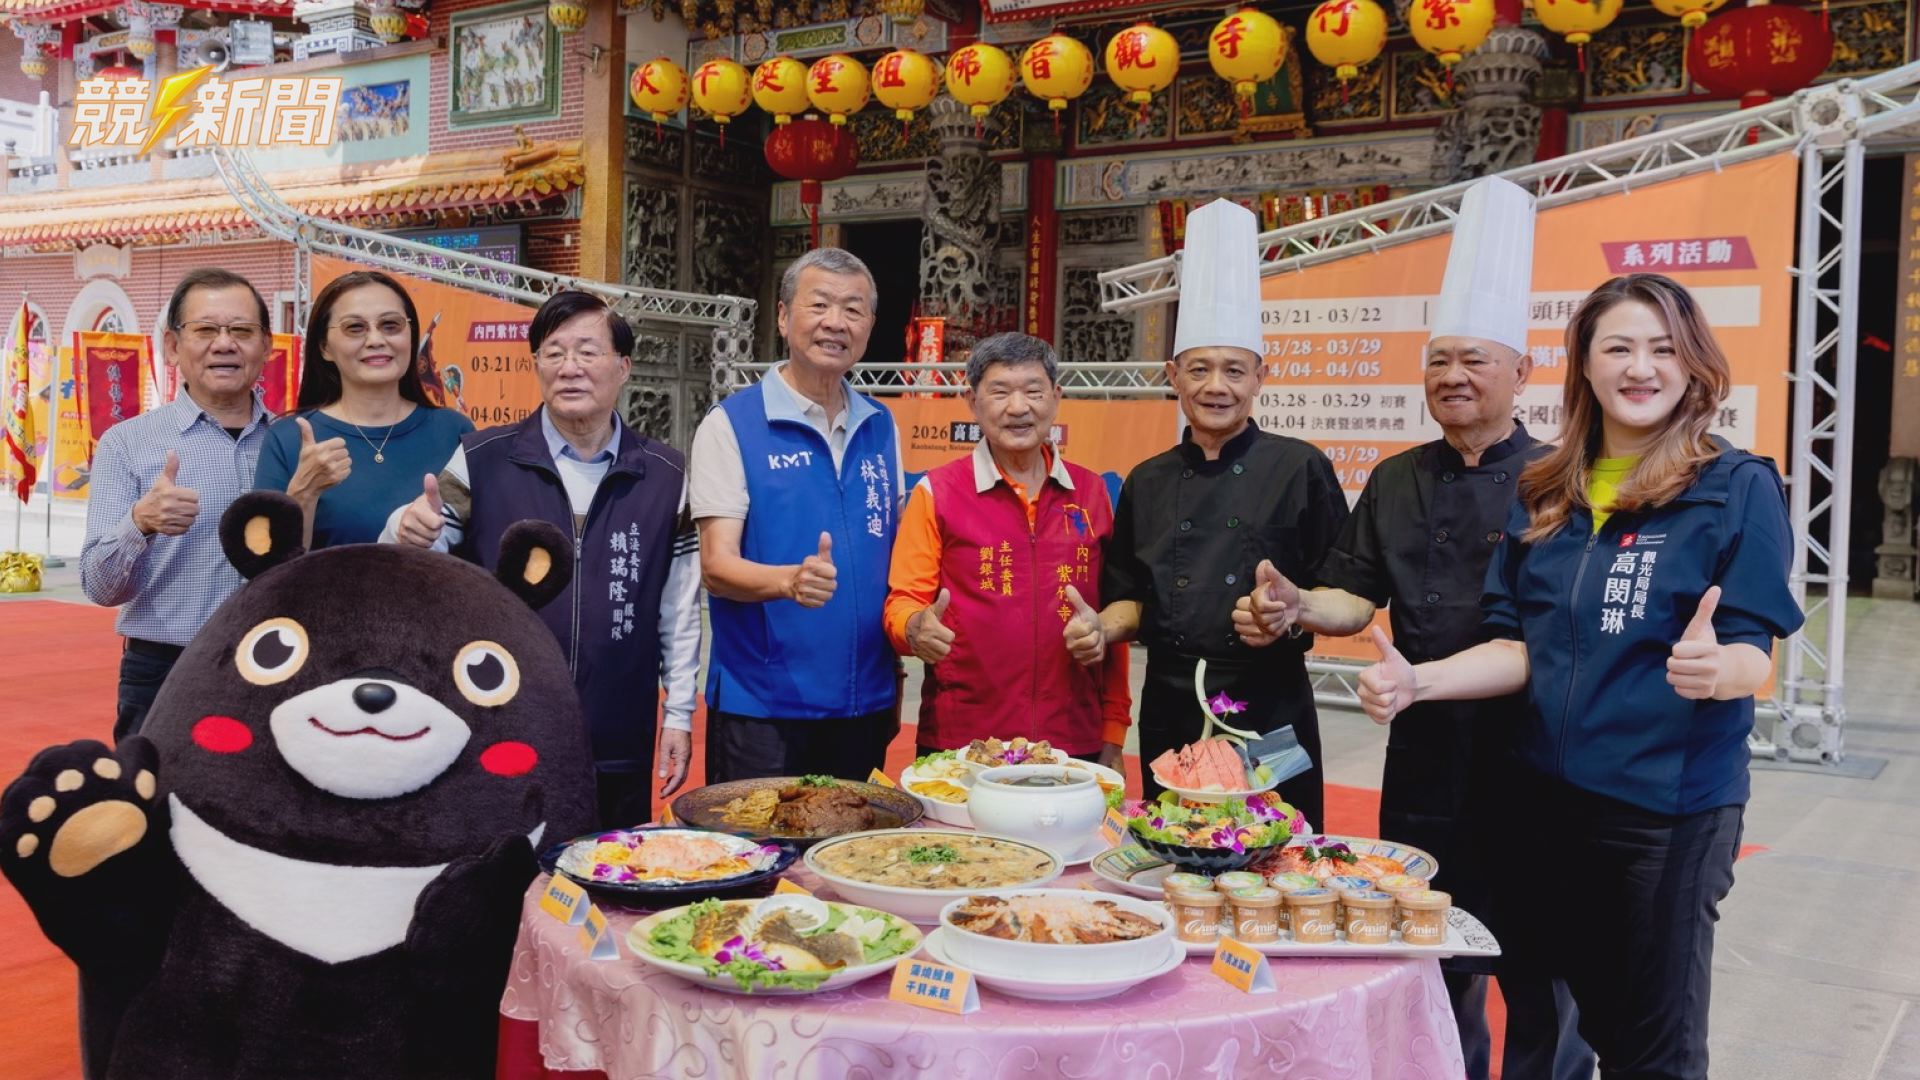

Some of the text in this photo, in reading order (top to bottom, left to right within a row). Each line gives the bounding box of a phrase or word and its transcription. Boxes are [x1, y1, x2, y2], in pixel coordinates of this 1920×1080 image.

[1315, 0, 1359, 37] 竹
[1115, 32, 1156, 70] 觀
[1214, 17, 1249, 59] 寺
[694, 60, 720, 96] 千
[811, 60, 844, 94] 聖
[876, 54, 905, 88] 祖
[949, 48, 981, 86] 佛
[1025, 42, 1058, 80] 音
[1621, 240, 1733, 268] 系列活動
[1261, 308, 1311, 325] 03/21
[1328, 307, 1382, 323] 03/22
[1528, 300, 1583, 321] 頭拜
[471, 355, 511, 373] 03.21
[1327, 337, 1382, 356] 03/29
[1270, 362, 1313, 379] 4/04
[1326, 361, 1381, 379] 04/05
[470, 406, 511, 424] 04.05
[1259, 393, 1307, 409] 03.28
[1322, 393, 1371, 408] 03.29
[1380, 395, 1407, 409] 初賽
[912, 425, 949, 440] 2026
[1259, 414, 1306, 429] 04.04
[768, 451, 813, 470] KMT
[860, 459, 884, 538] 林義迪
[609, 531, 629, 602] 賴瑞隆
[628, 522, 641, 583] 立法委員
[979, 546, 996, 592] 劉銀城
[999, 540, 1014, 597] 主任委員
[1077, 544, 1089, 583] 內門
[1600, 550, 1640, 635] 高閔琳
[1630, 551, 1657, 620] 觀光局局長
[1401, 919, 1439, 935] Omini
